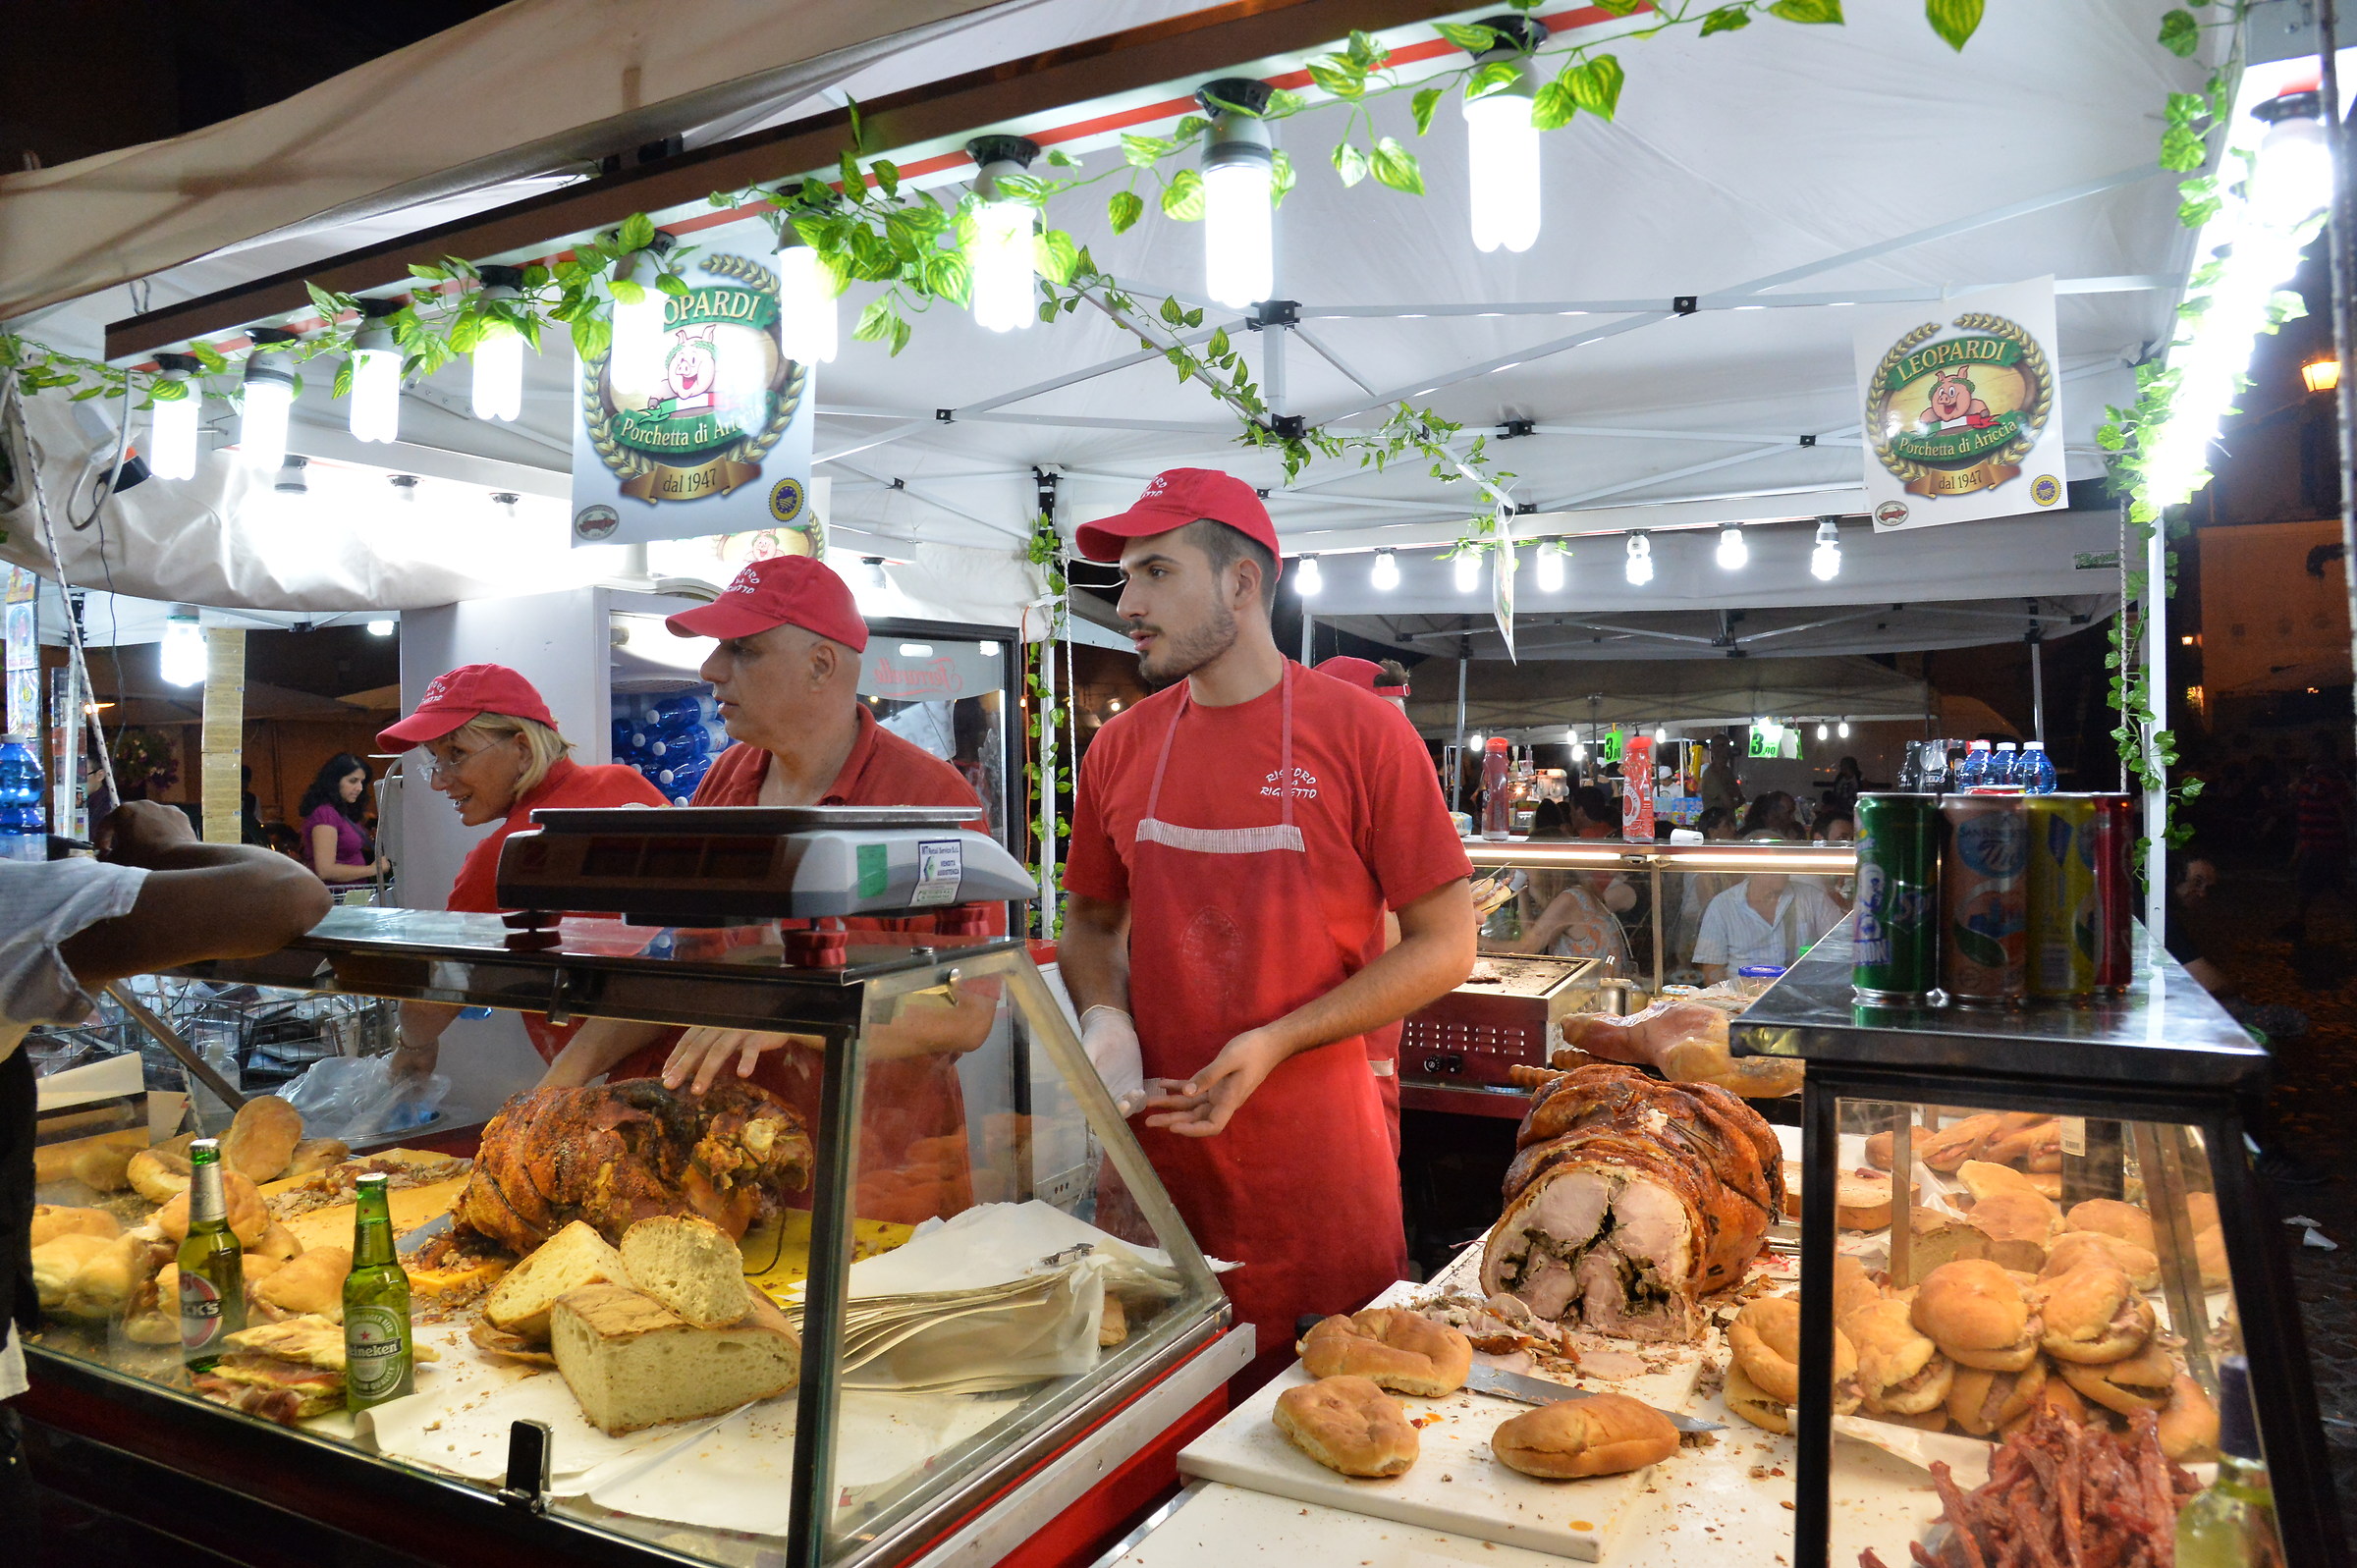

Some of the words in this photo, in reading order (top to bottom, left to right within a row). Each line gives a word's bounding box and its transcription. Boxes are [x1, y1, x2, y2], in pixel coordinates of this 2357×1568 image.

[663, 291, 762, 326] OPARDI
[1896, 339, 2008, 382] LEOPARDI
[621, 417, 689, 447] Porchetta
[694, 422, 709, 444] di
[1898, 437, 1954, 457] Porchetta
[1958, 435, 1971, 453] di
[1974, 419, 2018, 450] Ariccia
[662, 472, 683, 493] dal
[687, 468, 717, 491] 1947
[1939, 474, 1955, 489] dal
[1957, 469, 1983, 488] 1947
